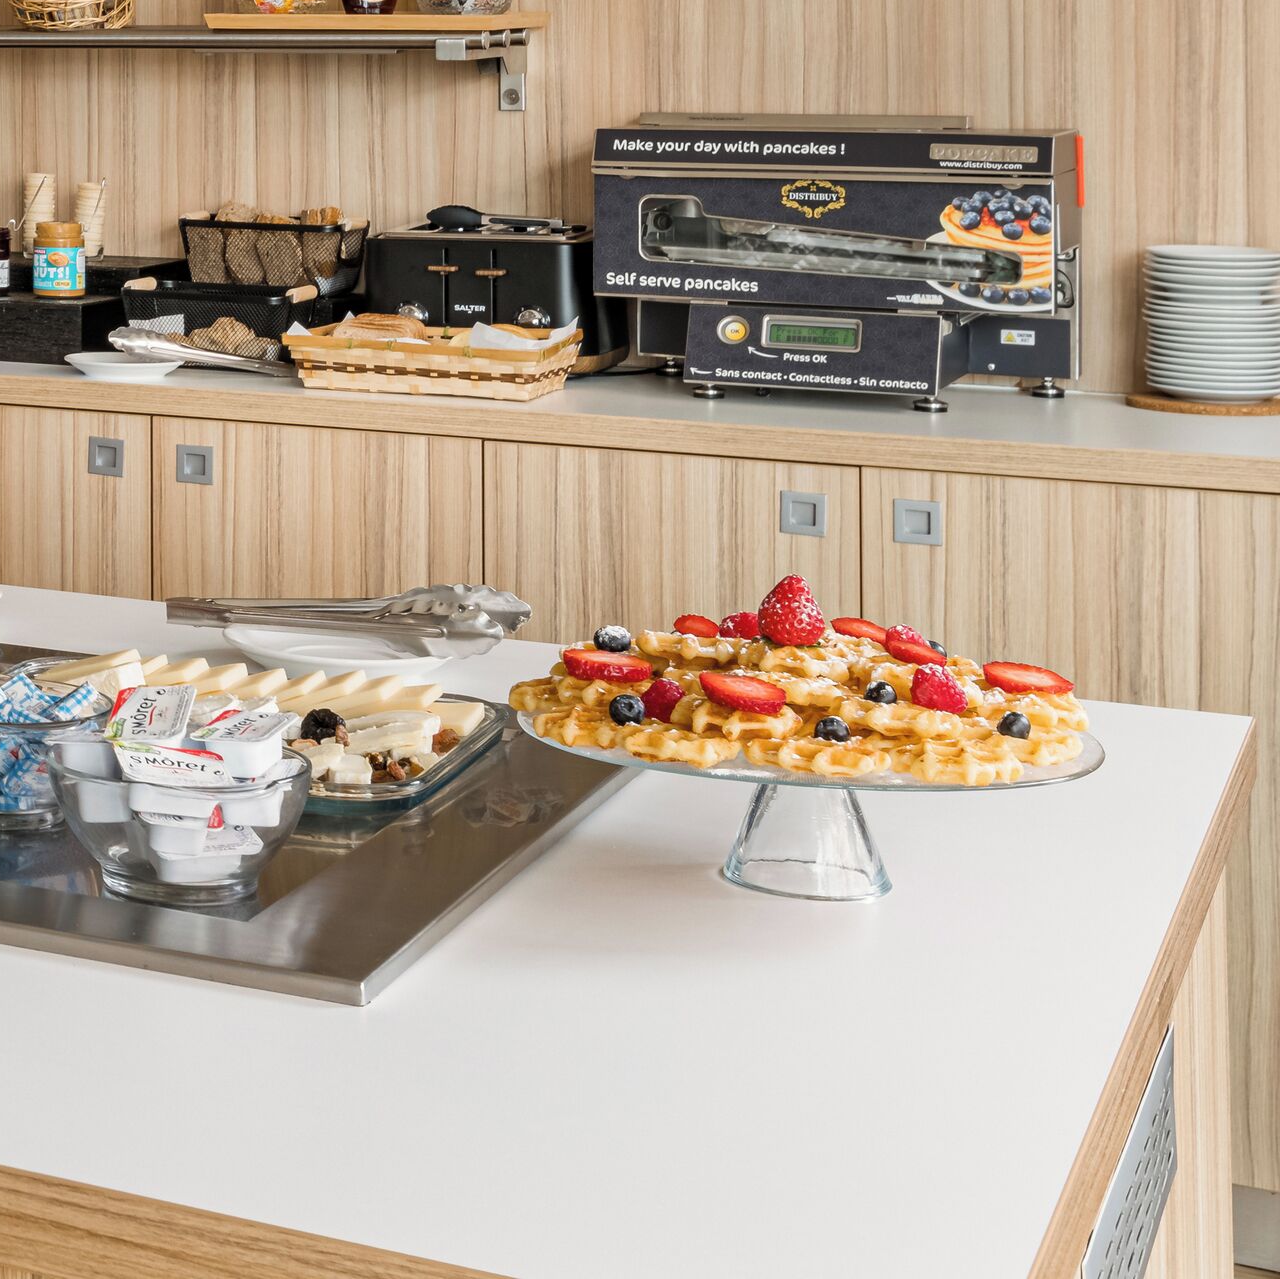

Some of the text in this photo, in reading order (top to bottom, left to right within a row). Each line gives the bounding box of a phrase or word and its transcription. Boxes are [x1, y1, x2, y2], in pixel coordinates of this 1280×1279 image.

[613, 139, 845, 156] Make your day with pancakes !
[939, 160, 1023, 170] www.distribuy.com
[789, 191, 838, 202] DISTRIBUY
[606, 272, 759, 292] Self serve pancakes
[454, 304, 486, 312] SALTER
[783, 353, 828, 363] Press OK
[715, 368, 928, 390] Sans contact Contactless Sin contacto
